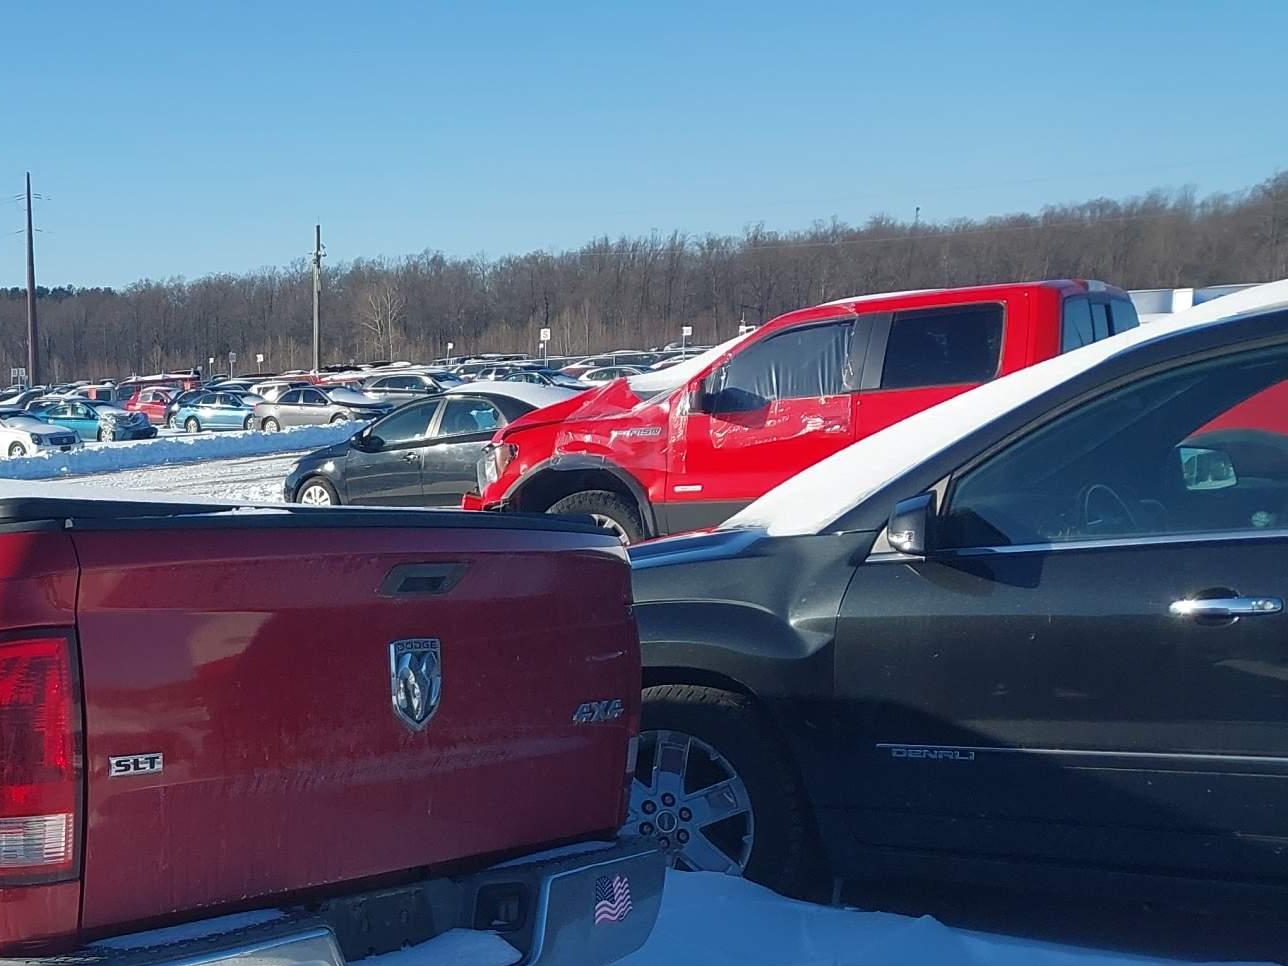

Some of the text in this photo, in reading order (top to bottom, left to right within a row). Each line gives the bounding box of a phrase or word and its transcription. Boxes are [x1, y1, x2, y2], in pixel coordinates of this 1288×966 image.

[395, 640, 438, 651] DODGE
[891, 747, 975, 761] DENALI
[114, 756, 160, 773] SLT
